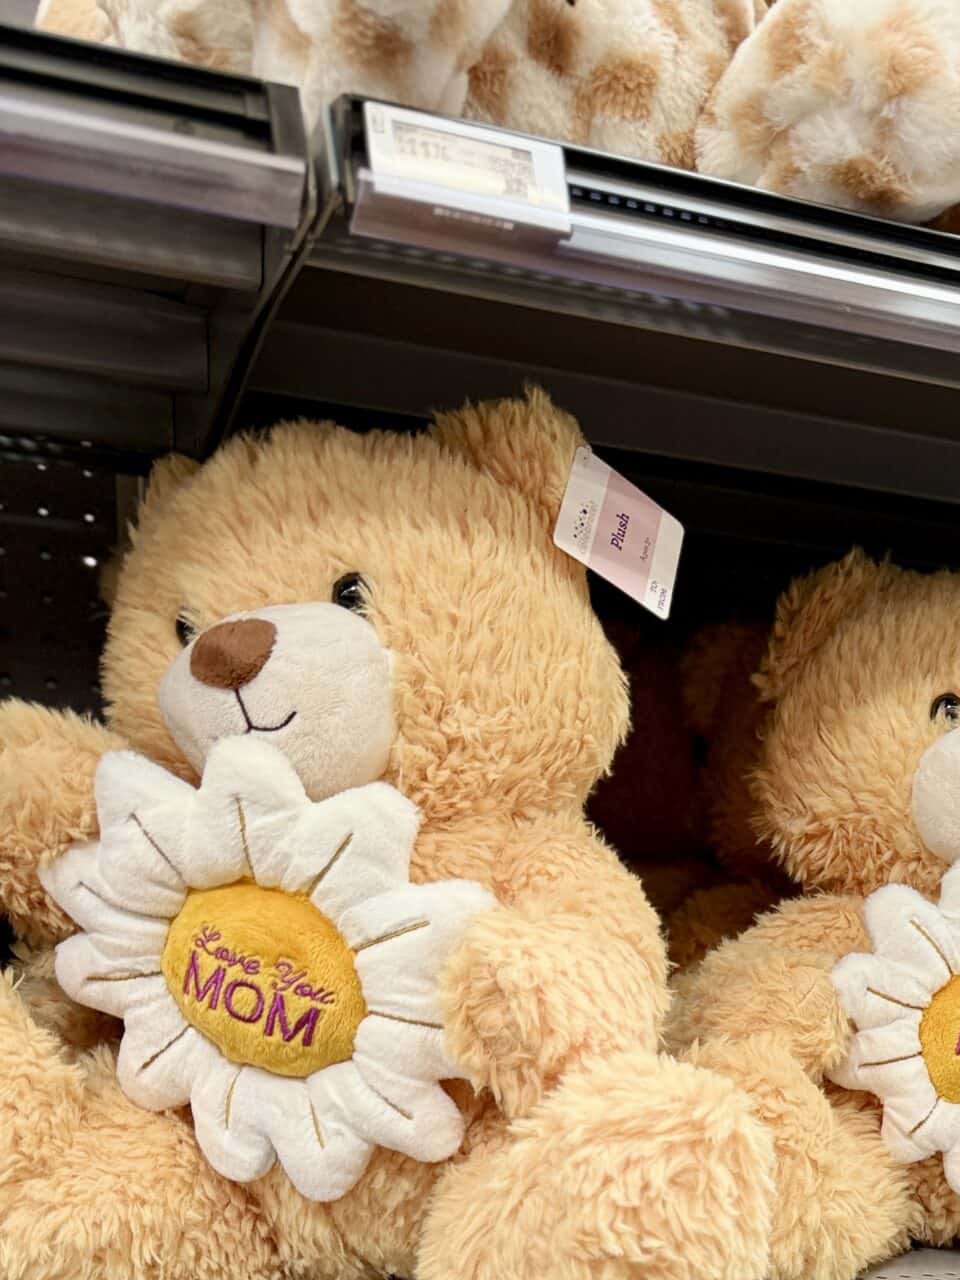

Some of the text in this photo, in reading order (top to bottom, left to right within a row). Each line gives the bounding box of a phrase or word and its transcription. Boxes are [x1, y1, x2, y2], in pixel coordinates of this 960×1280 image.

[610, 513, 630, 551] Plush
[183, 950, 322, 1047] MOM
[195, 925, 335, 1005] Love You
